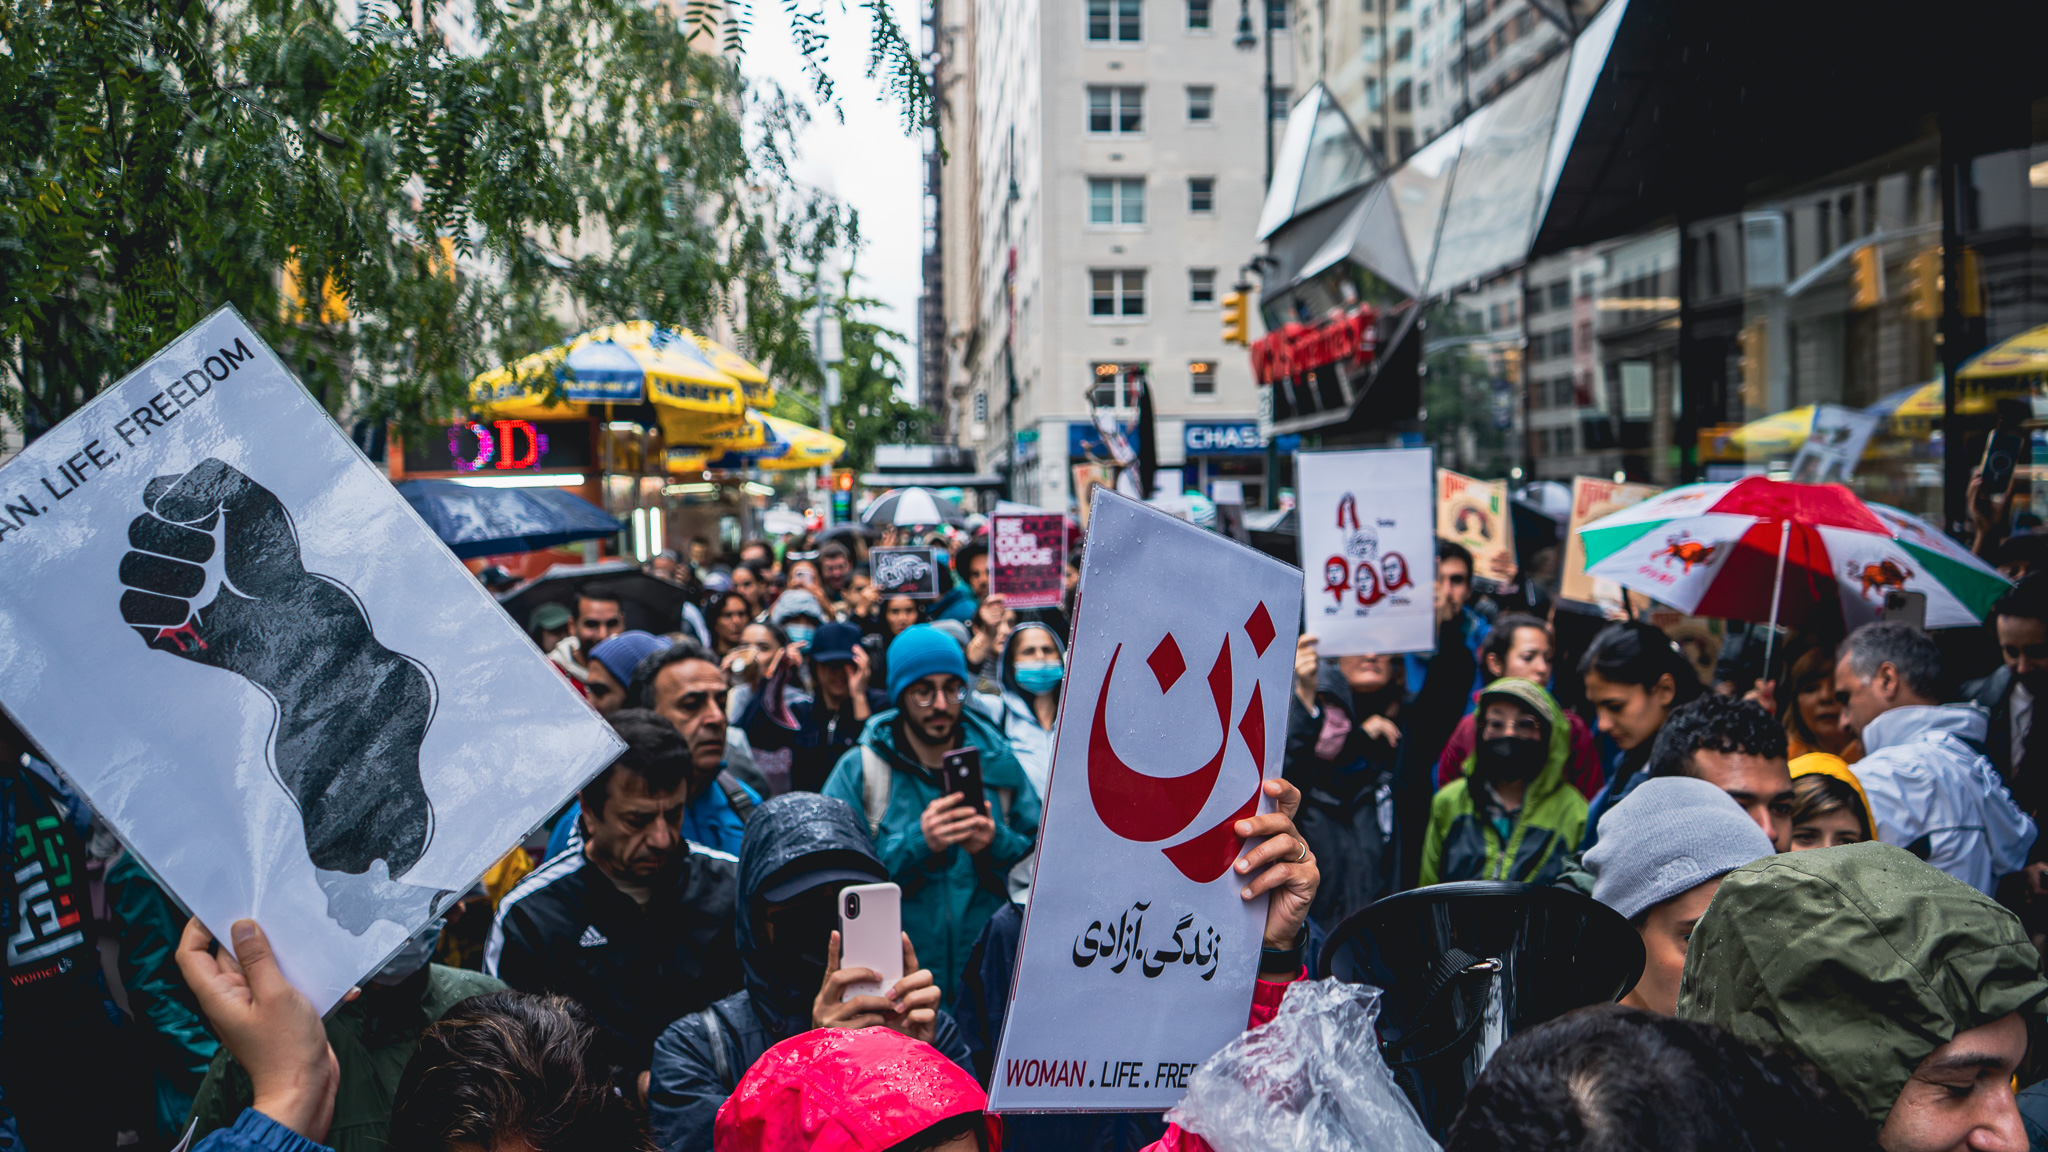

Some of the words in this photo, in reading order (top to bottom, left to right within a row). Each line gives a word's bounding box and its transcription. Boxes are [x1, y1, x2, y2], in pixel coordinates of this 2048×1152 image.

[113, 337, 255, 448] FREEDOM
[1187, 426, 1270, 449] CHAS
[996, 519, 1023, 535] BE
[996, 534, 1037, 551] OUR
[997, 548, 1053, 567] VOICE
[1088, 600, 1276, 883] زن
